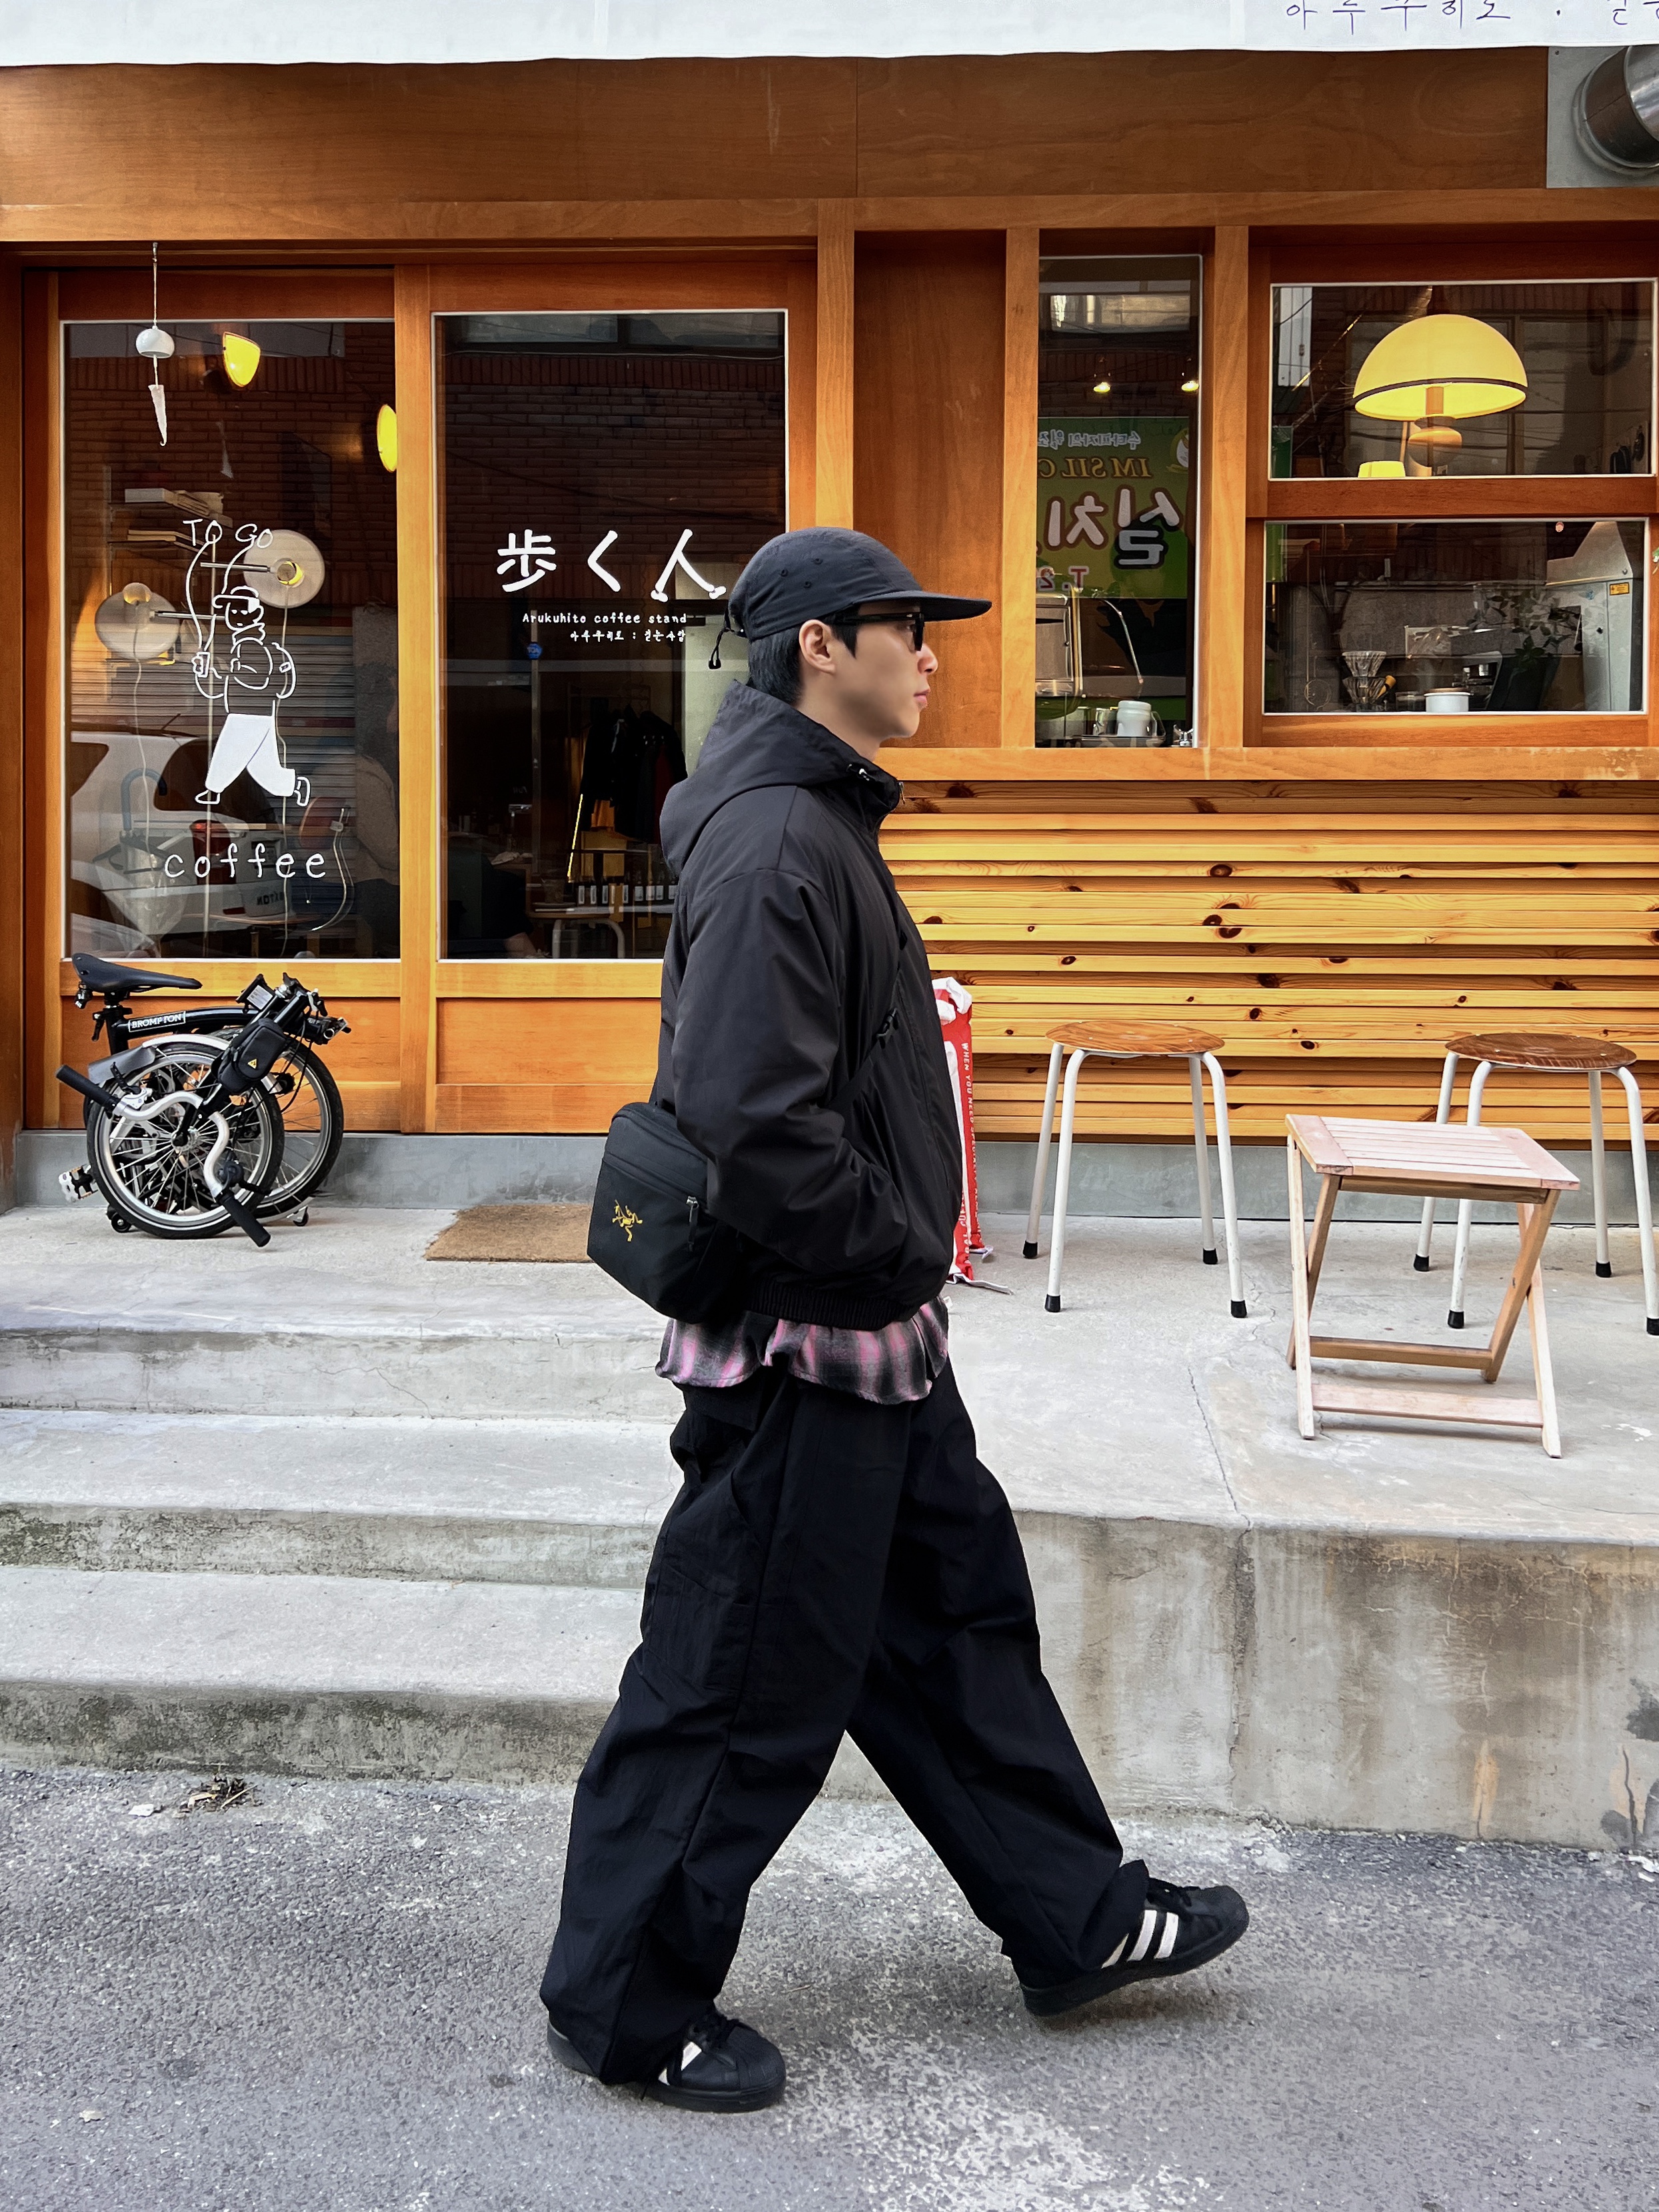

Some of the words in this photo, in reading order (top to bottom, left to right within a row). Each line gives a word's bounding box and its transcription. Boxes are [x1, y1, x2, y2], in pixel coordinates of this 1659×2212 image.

[183, 519, 223, 546] TO
[235, 523, 273, 549] GO
[497, 529, 727, 602] 歩く人
[522, 612, 587, 624] Arukuhito
[594, 612, 641, 624] coffee
[648, 612, 687, 624] stand
[165, 842, 326, 878] coffee
[131, 1013, 182, 1028] BROMPTON
[961, 1042, 970, 1071] WHEN
